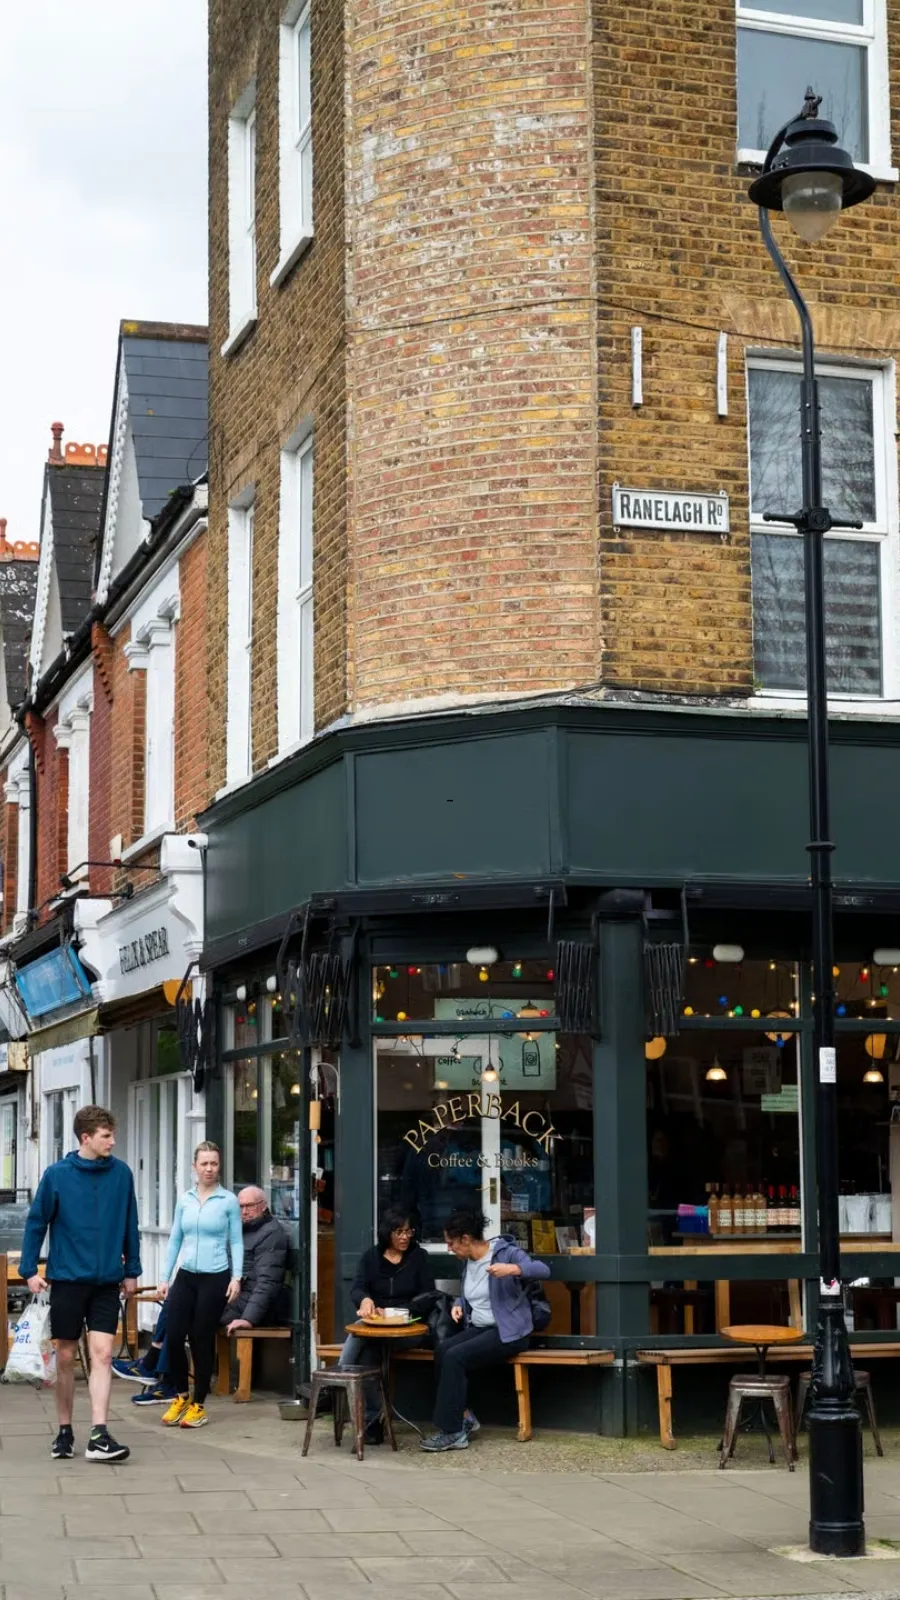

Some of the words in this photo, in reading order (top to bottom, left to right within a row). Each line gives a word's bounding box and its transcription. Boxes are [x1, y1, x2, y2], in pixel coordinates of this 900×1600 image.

[620, 494, 703, 525] RANELAGH
[403, 1093, 564, 1154] PAPERBACK
[427, 1152, 473, 1168] Coffee
[476, 1152, 491, 1168] &
[494, 1151, 539, 1168] Books
